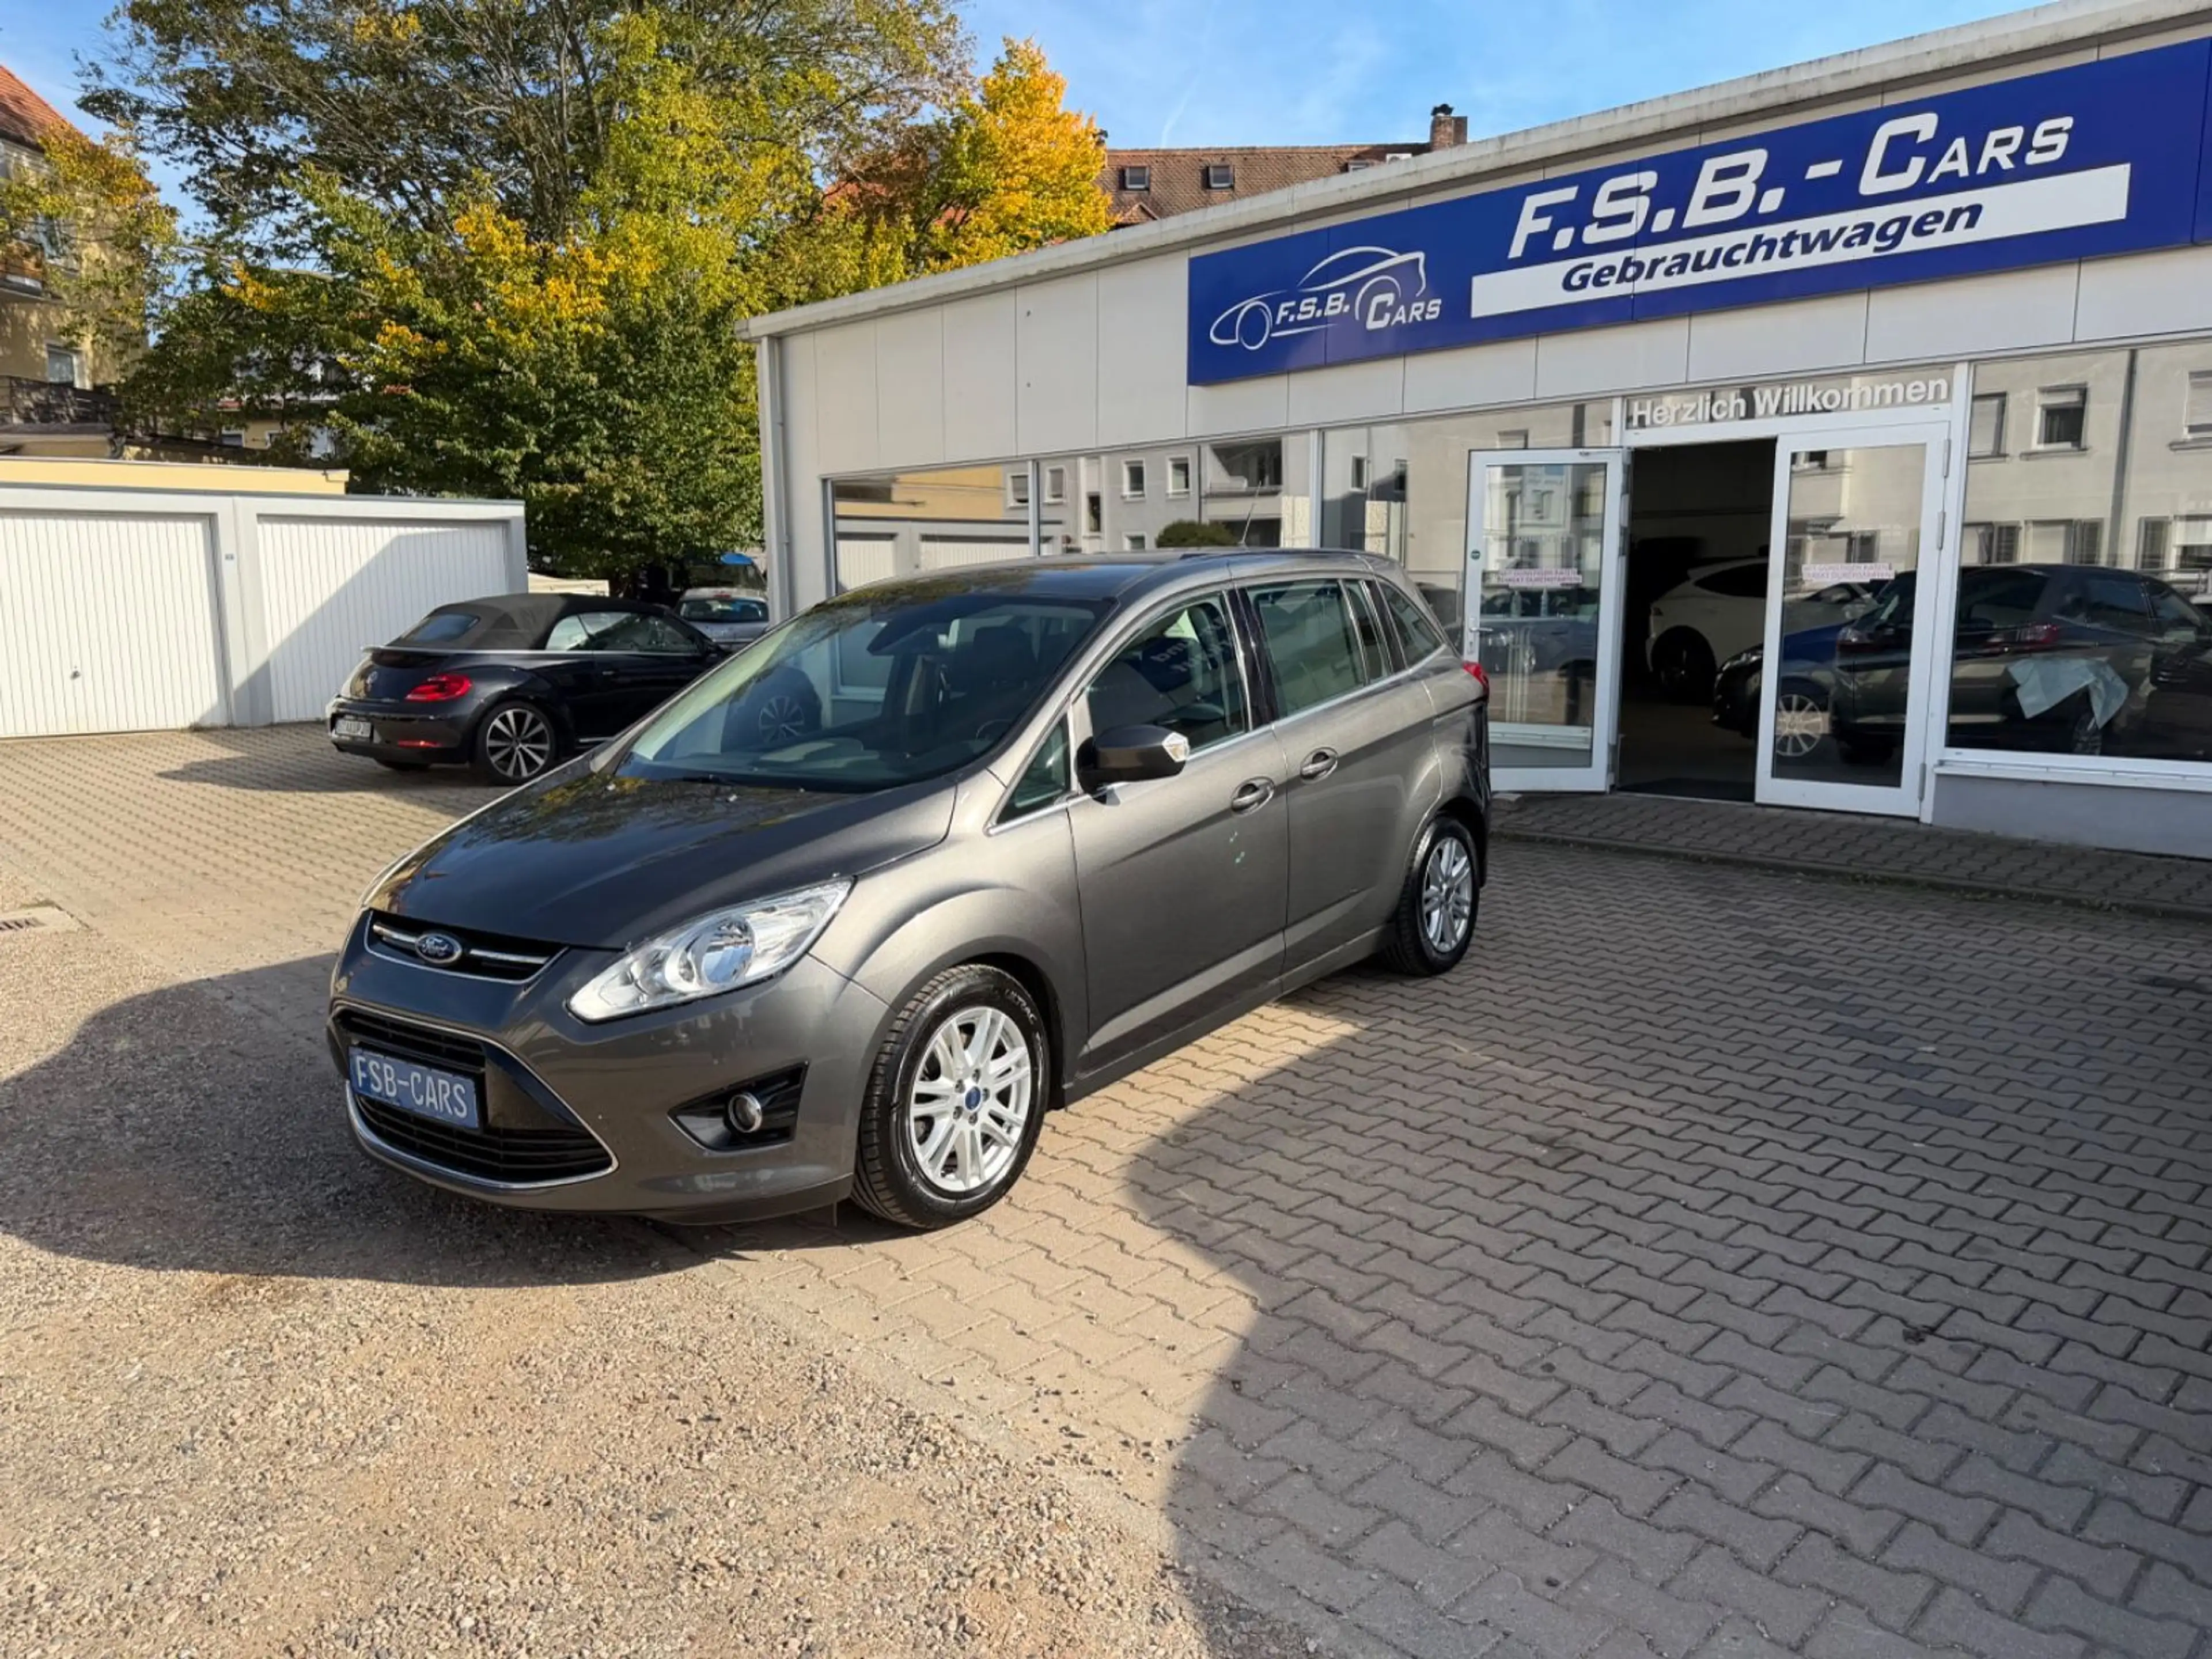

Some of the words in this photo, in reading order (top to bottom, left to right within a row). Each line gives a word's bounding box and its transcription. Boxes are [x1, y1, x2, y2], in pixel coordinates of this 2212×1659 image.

[1562, 203, 1984, 291] Gebrauchtwagen
[1275, 291, 1350, 325] F.S.B.
[1631, 388, 1746, 427] Herzlich
[1753, 377, 1948, 416] Willkommen
[355, 1055, 468, 1118] FSB-CARS
